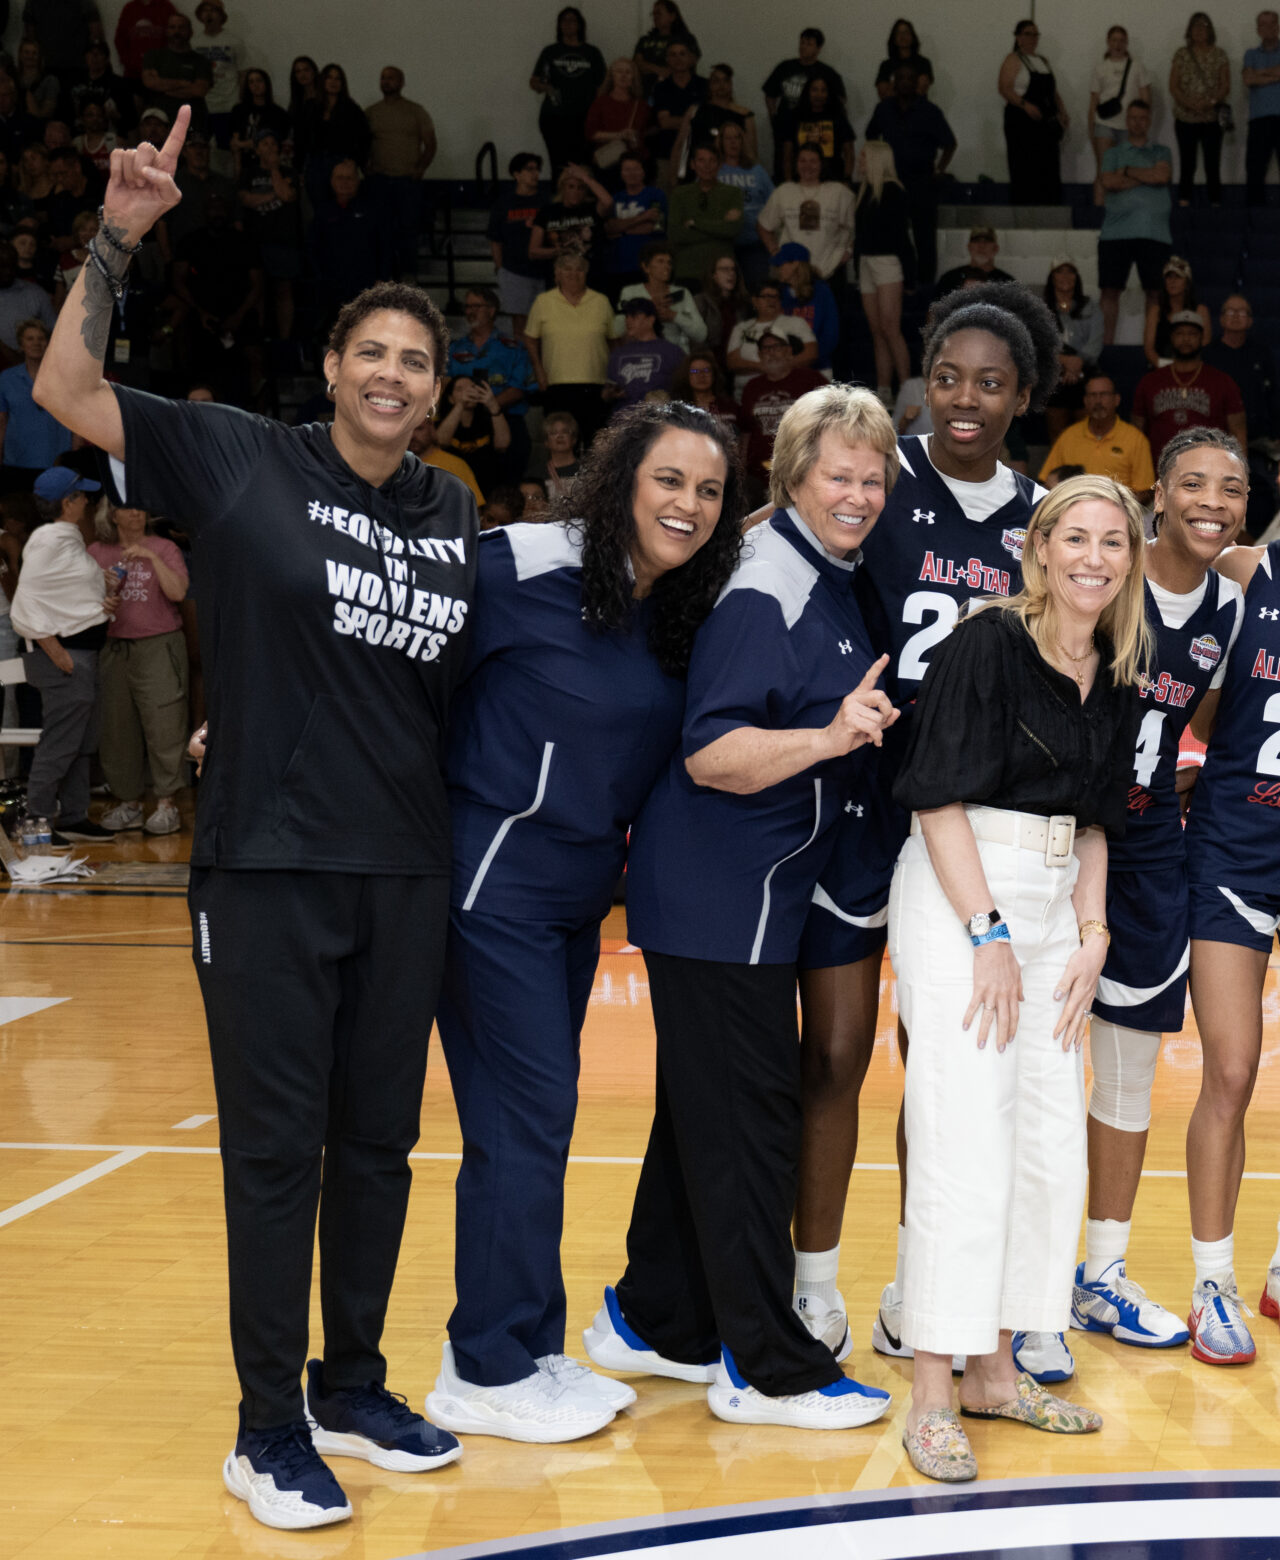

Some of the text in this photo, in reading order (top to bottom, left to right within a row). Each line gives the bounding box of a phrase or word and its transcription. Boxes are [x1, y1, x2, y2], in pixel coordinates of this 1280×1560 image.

[308, 500, 467, 565] #EQUALITY
[325, 559, 469, 633] WOMENS
[333, 600, 448, 662] SPORTS
[199, 911, 212, 964] #EQUALITY
